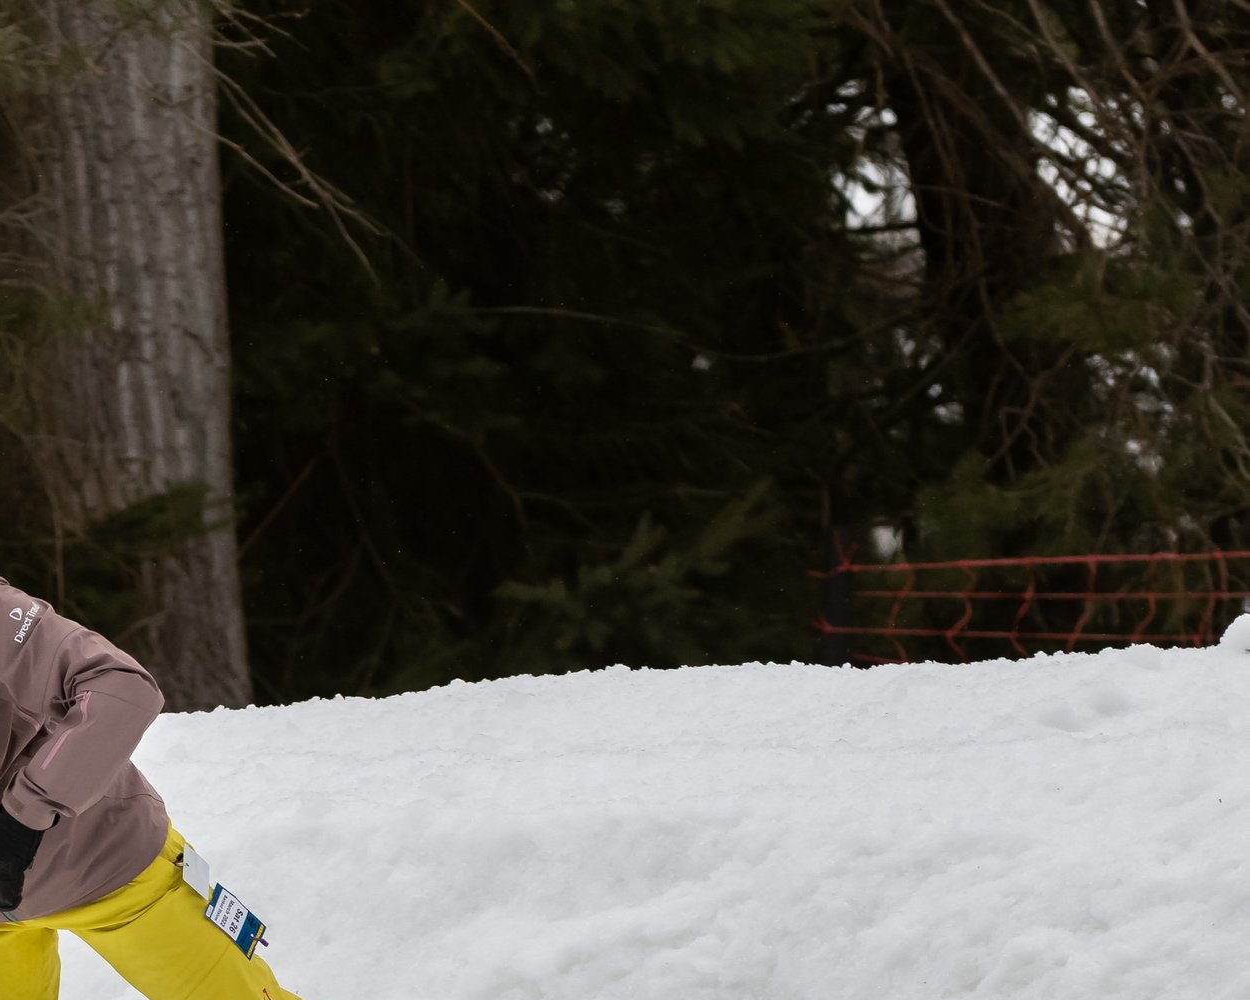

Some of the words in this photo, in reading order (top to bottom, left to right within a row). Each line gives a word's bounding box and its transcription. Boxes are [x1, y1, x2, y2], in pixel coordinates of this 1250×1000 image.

[14, 616, 33, 643] Direct
[226, 900, 235, 914] March
[233, 908, 243, 923] Sat
[229, 922, 238, 934] 26
